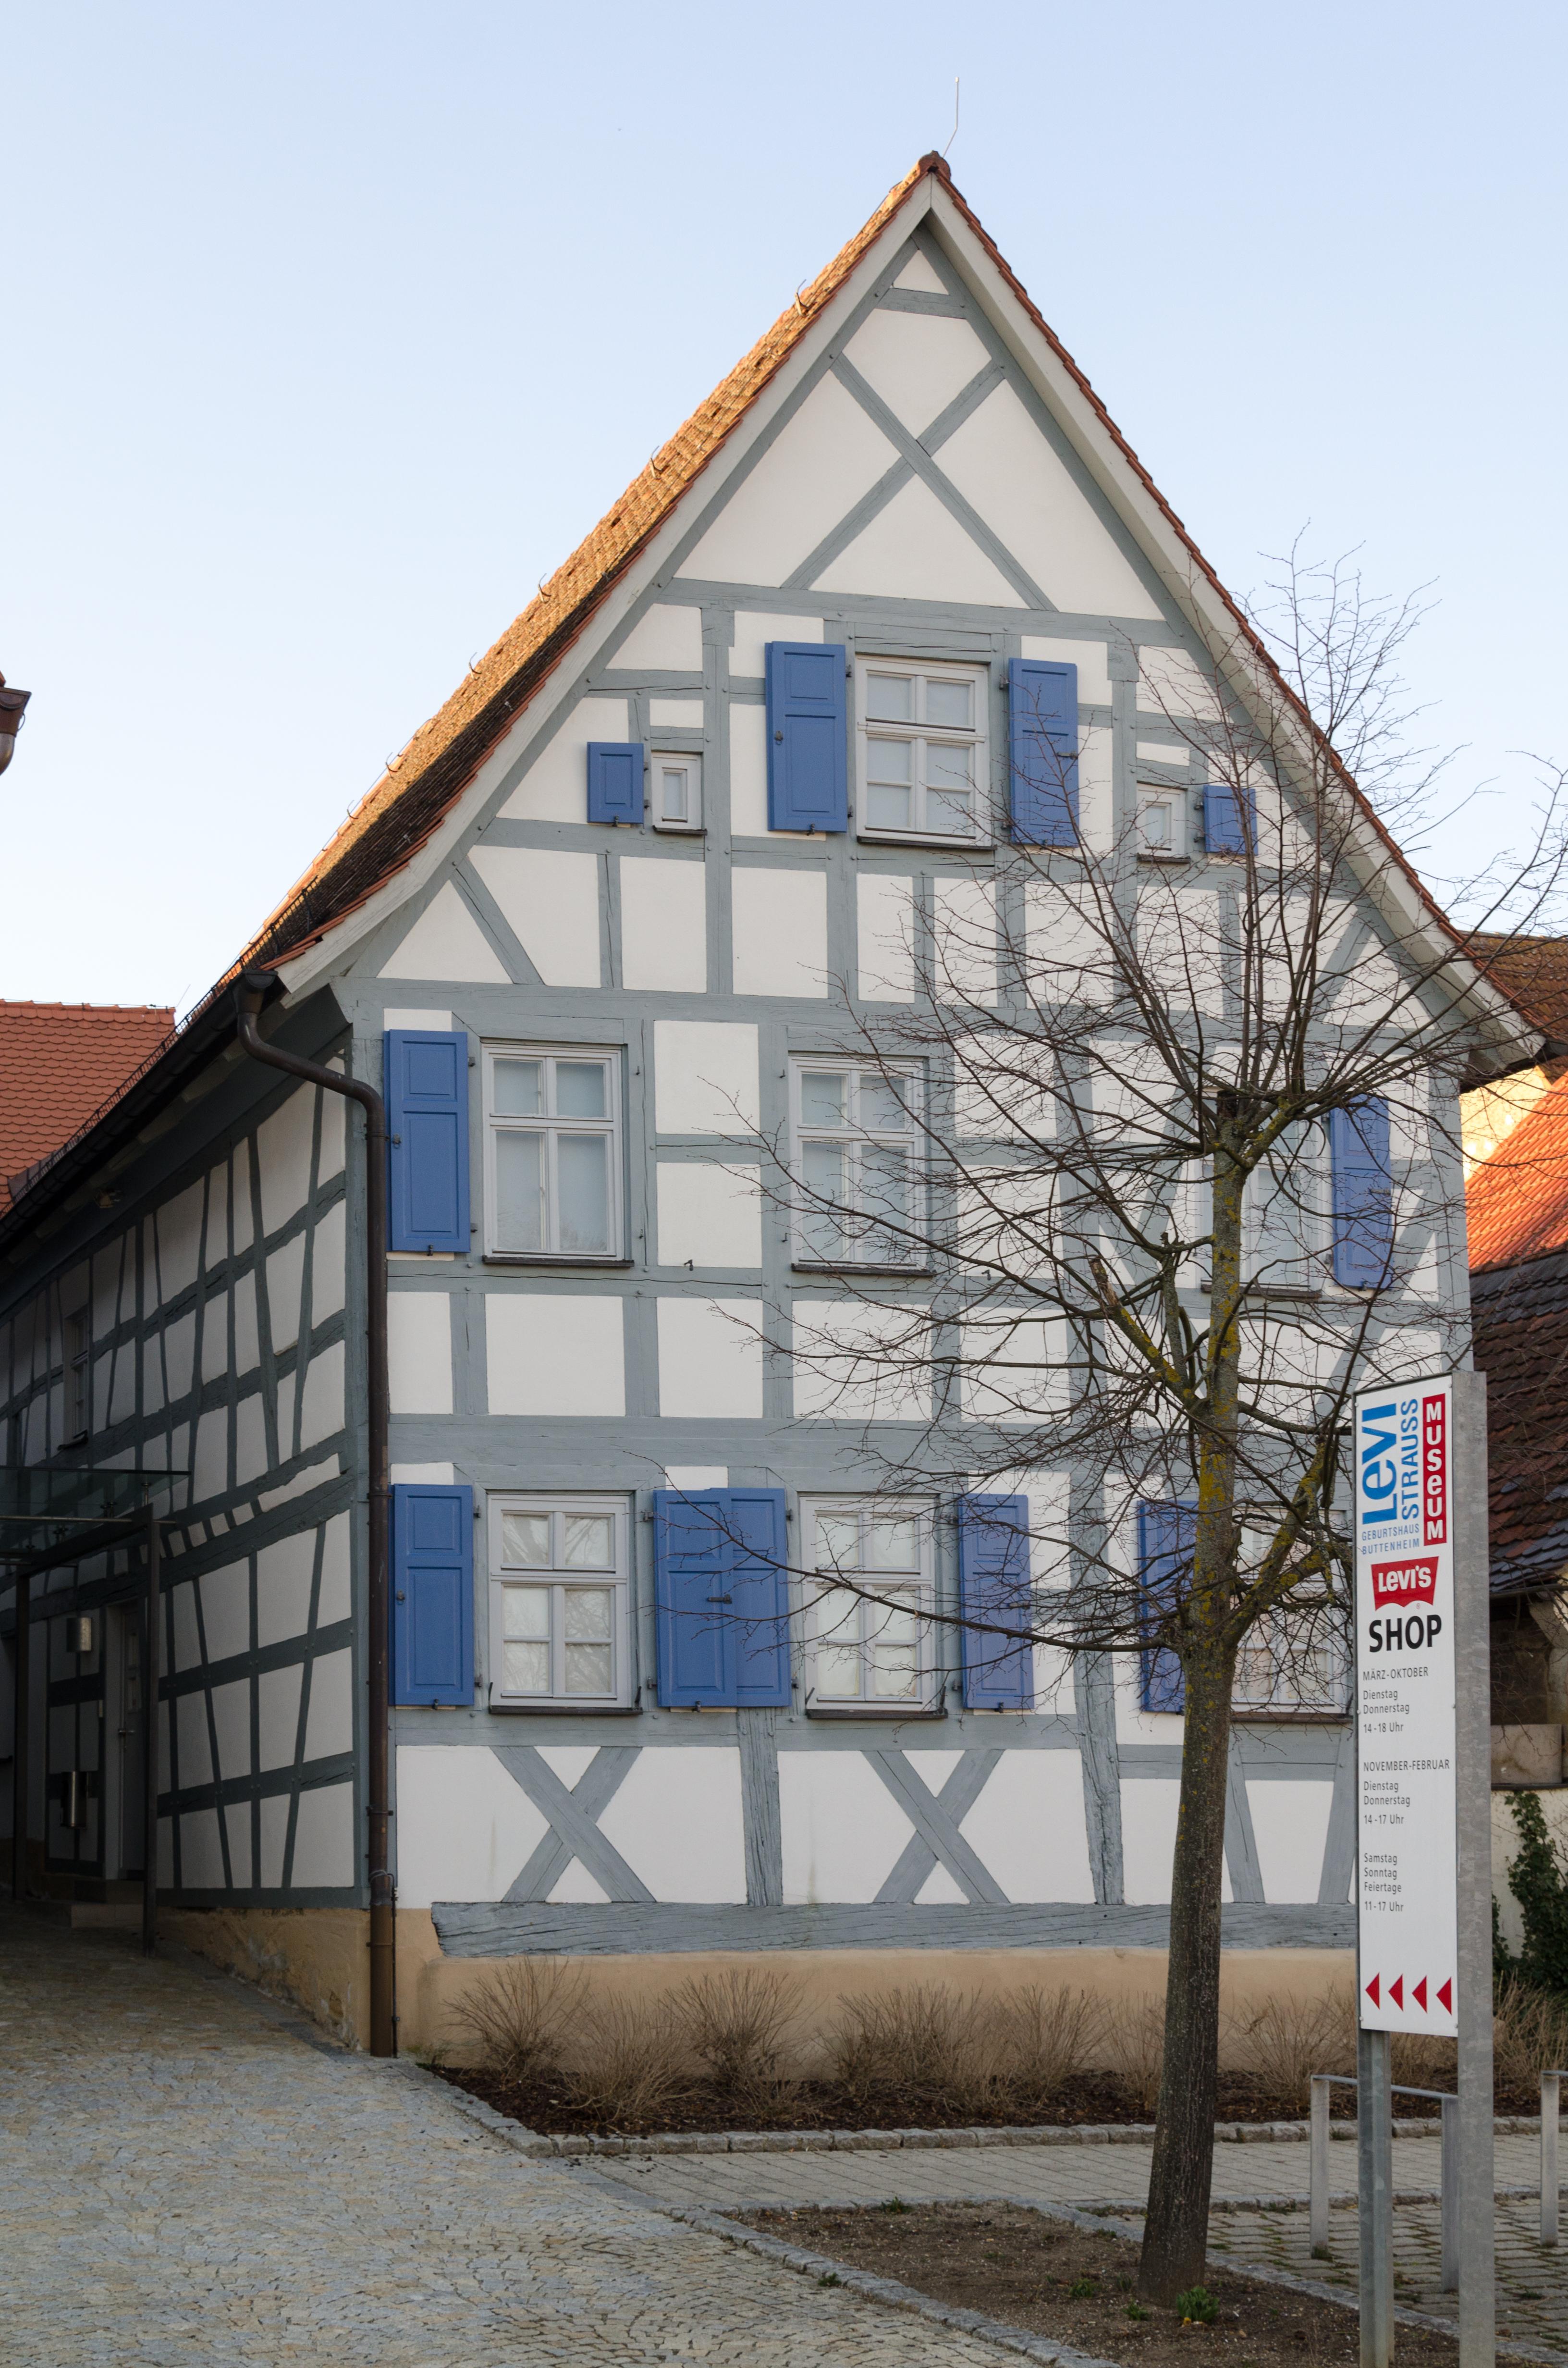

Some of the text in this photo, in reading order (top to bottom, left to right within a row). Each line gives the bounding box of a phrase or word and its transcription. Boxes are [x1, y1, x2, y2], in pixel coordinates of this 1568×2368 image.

[1400, 1399, 1419, 1520] STRAUSS
[1361, 1523, 1420, 1541] GEBURTSHAUS
[1361, 1538, 1420, 1555] BUTTENHEIM
[1369, 1614, 1442, 1653] SHOP
[1363, 1690, 1398, 1701] Dienstag
[1363, 1703, 1409, 1714] Donnerstag
[1389, 1722, 1403, 1732] Uhr
[1364, 1780, 1398, 1793] Dienstag
[1364, 1795, 1410, 1807] Donnerstag
[1390, 1814, 1404, 1824] Uhr
[1364, 1852, 1397, 1866] Samstag
[1364, 1867, 1397, 1880] Sonntag
[1364, 1881, 1402, 1895] Feiertage
[1389, 1901, 1404, 1912] Uhr
